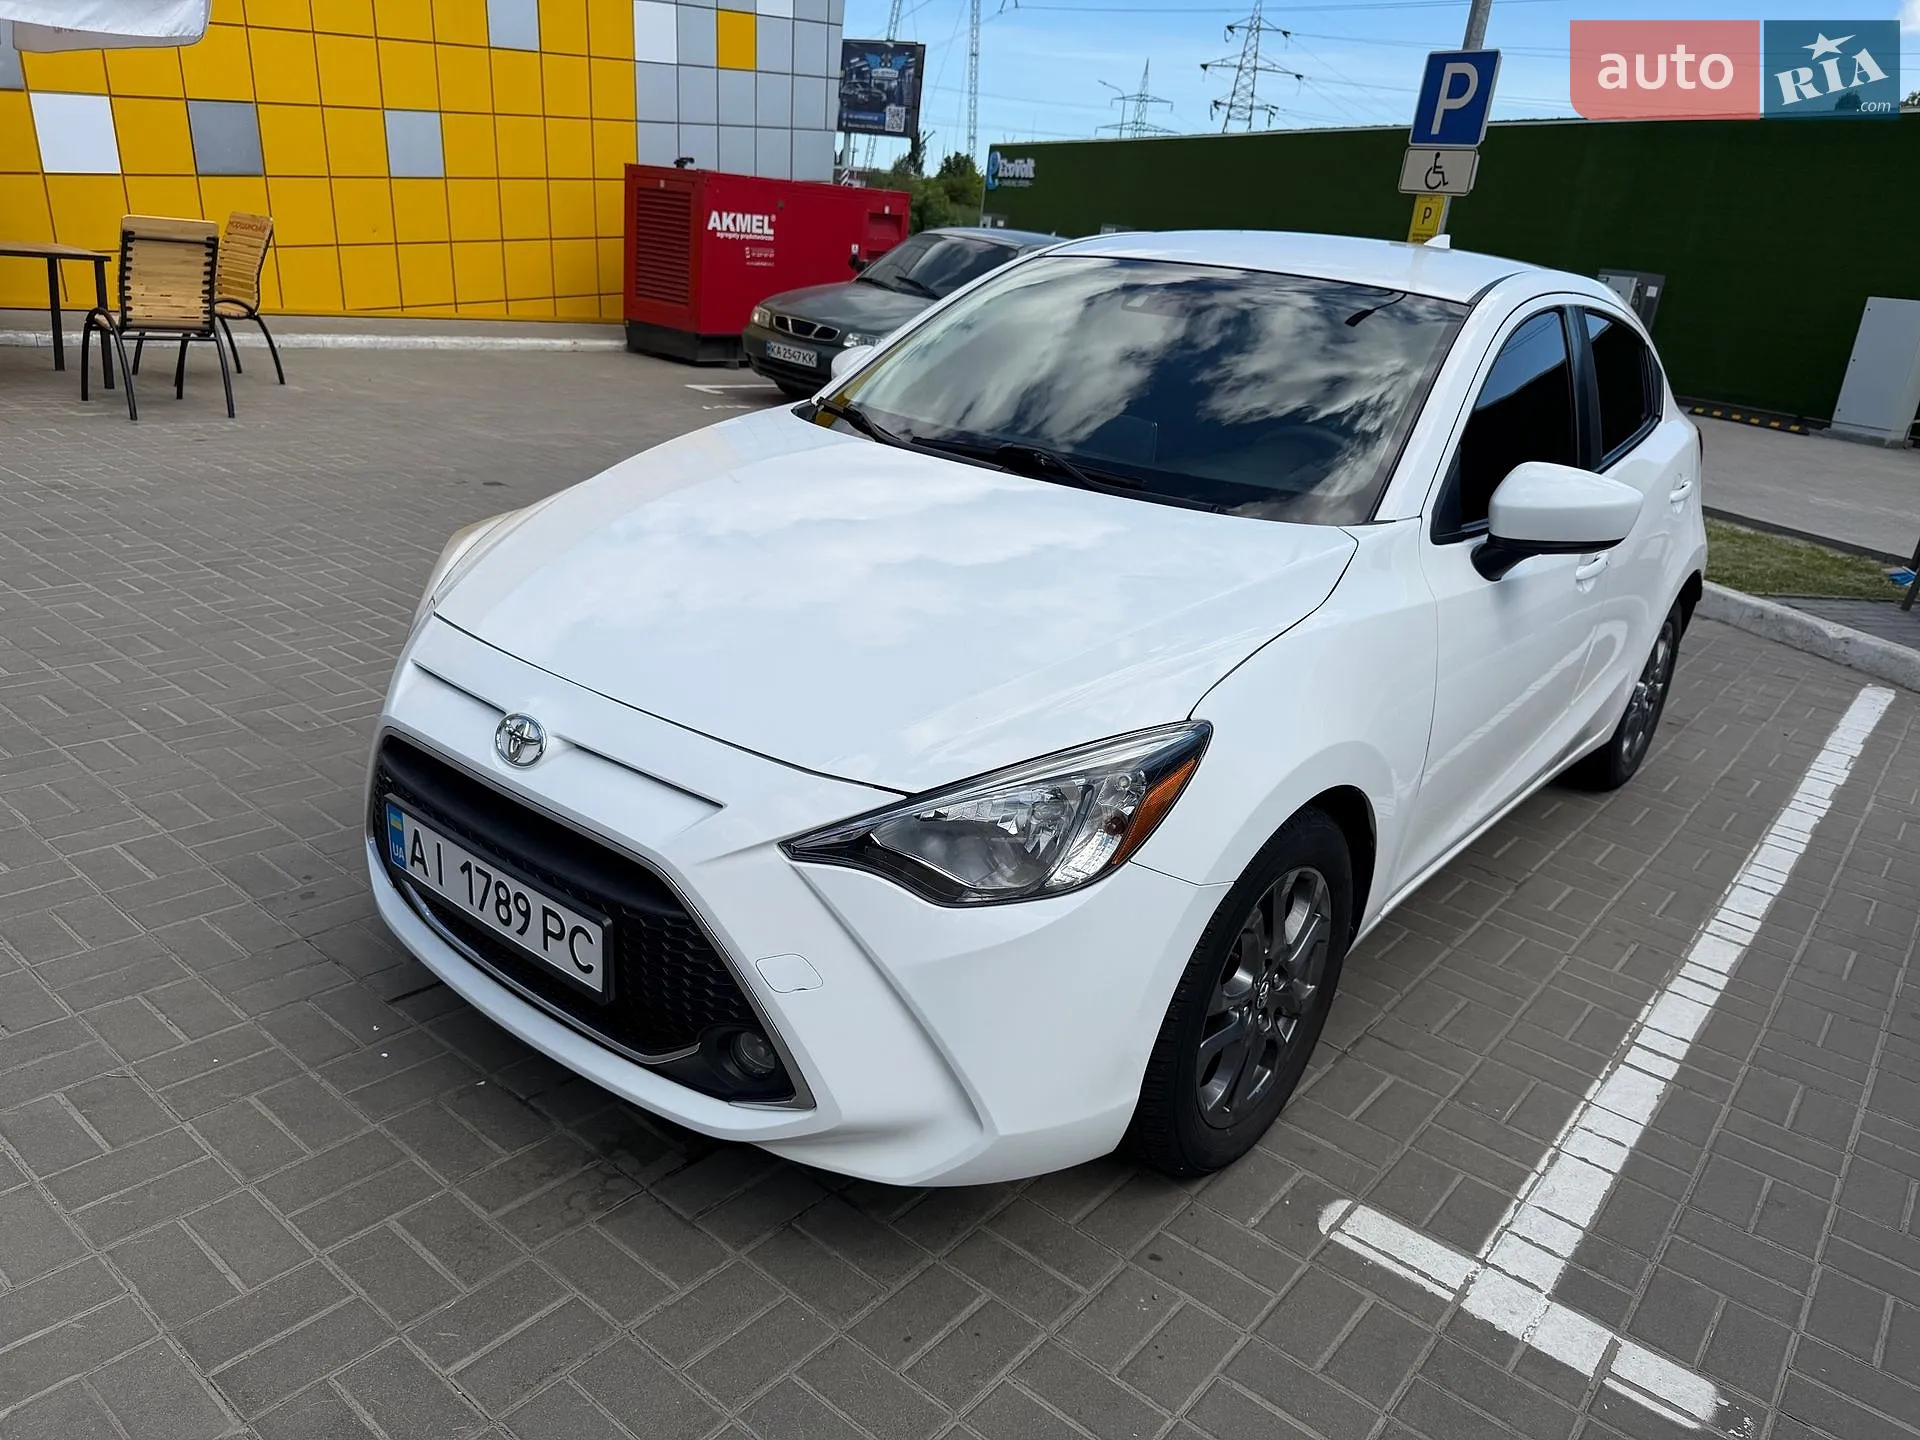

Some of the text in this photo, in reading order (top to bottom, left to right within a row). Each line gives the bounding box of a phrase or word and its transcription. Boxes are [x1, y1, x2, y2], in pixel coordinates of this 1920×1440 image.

[1431, 62, 1479, 135] P
[707, 210, 775, 235] AKMEL
[1421, 206, 1433, 225] P
[392, 841, 405, 861] UA
[410, 827, 595, 974] AI 1789 PC
